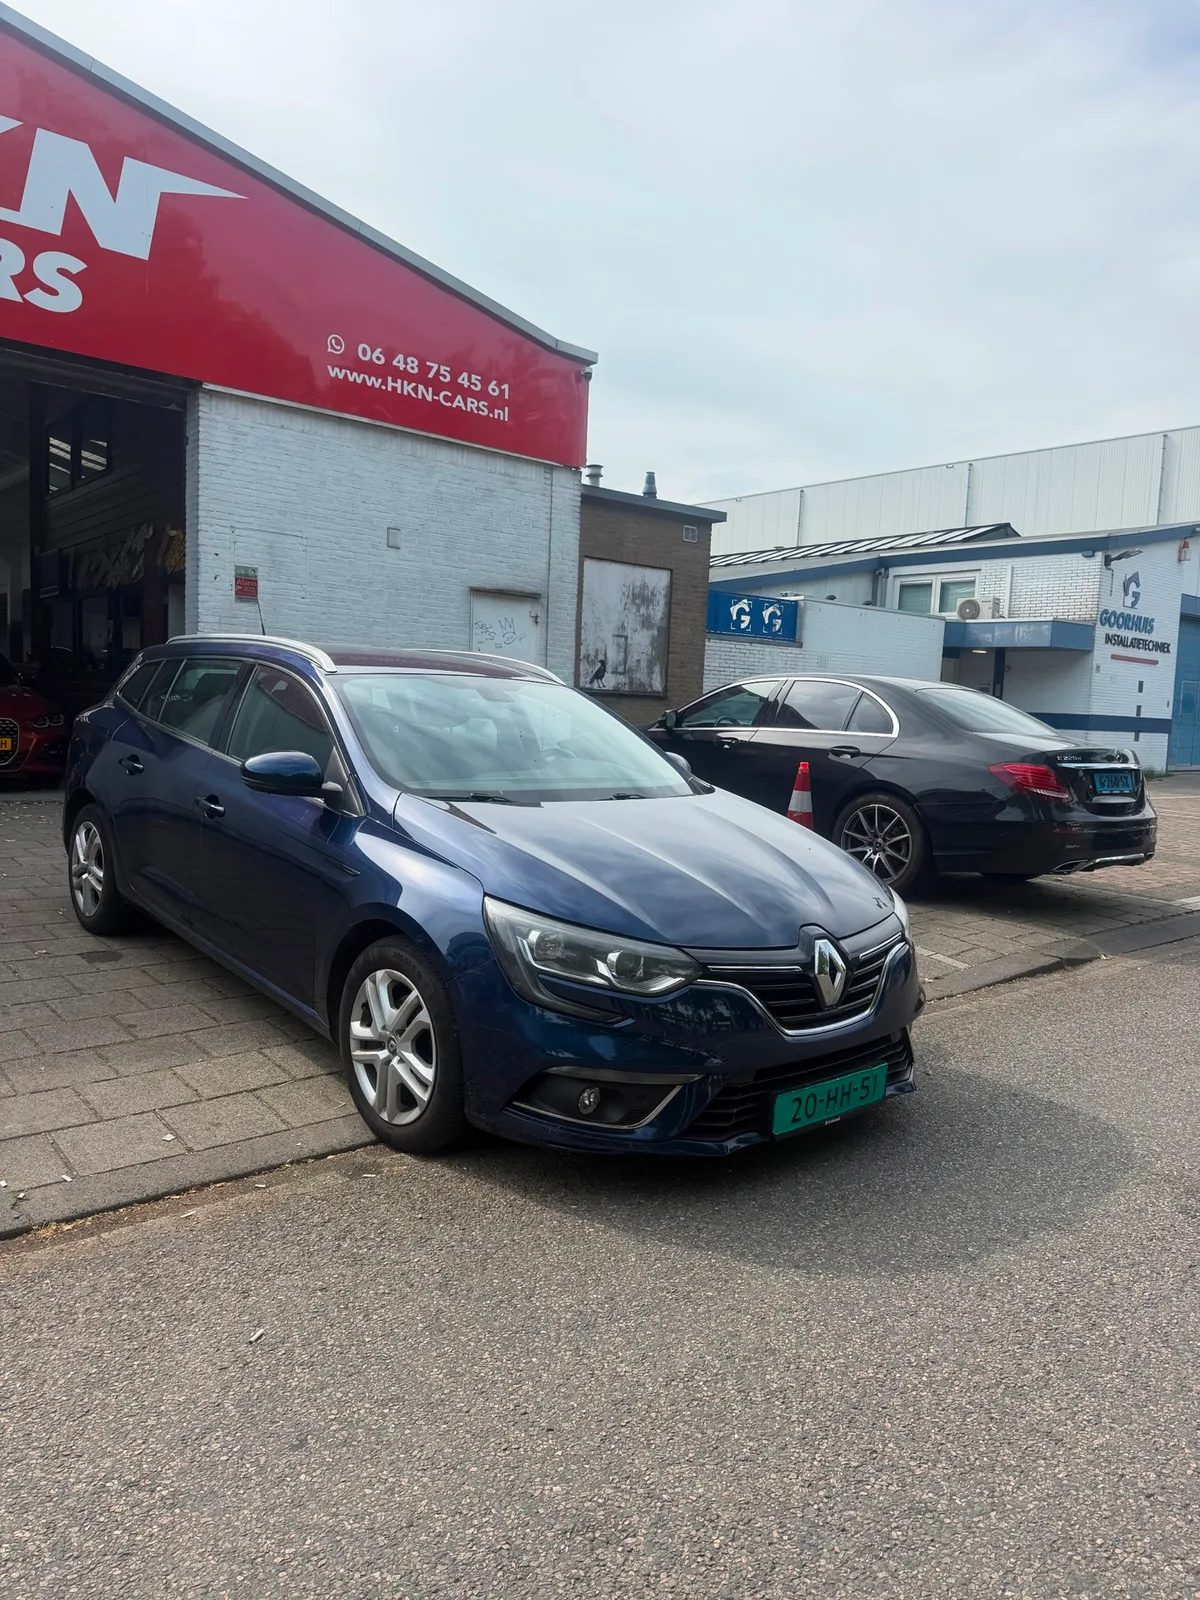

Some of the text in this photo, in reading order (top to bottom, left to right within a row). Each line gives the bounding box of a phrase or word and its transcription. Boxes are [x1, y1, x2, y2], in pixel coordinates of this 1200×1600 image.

[327, 364, 509, 422] www.HKN-CARS.nl
[357, 343, 510, 400] 06 48 75 45 61
[1099, 608, 1156, 635] GOORHUIS
[1104, 632, 1171, 654] INSTALLATIETECHNIEK
[790, 1073, 879, 1124] 20-HH-51
